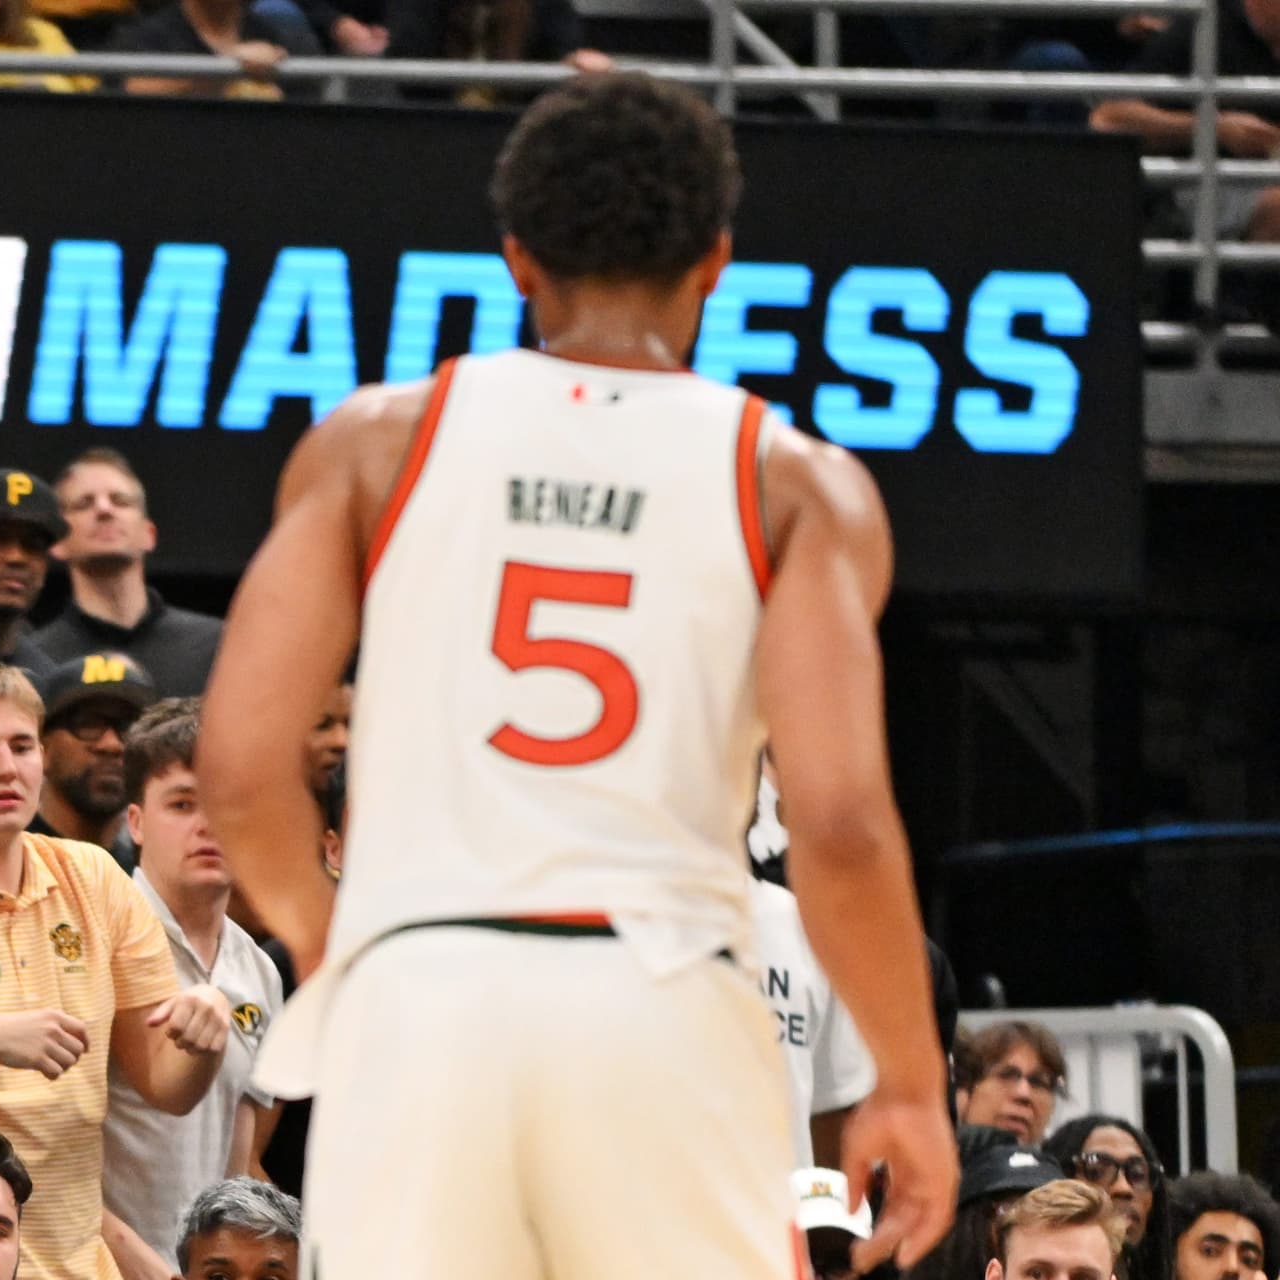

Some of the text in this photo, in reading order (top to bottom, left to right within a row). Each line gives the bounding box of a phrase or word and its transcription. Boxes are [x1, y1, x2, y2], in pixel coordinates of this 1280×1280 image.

[6, 472, 33, 506] P
[81, 655, 126, 684] M
[487, 559, 639, 767] 5
